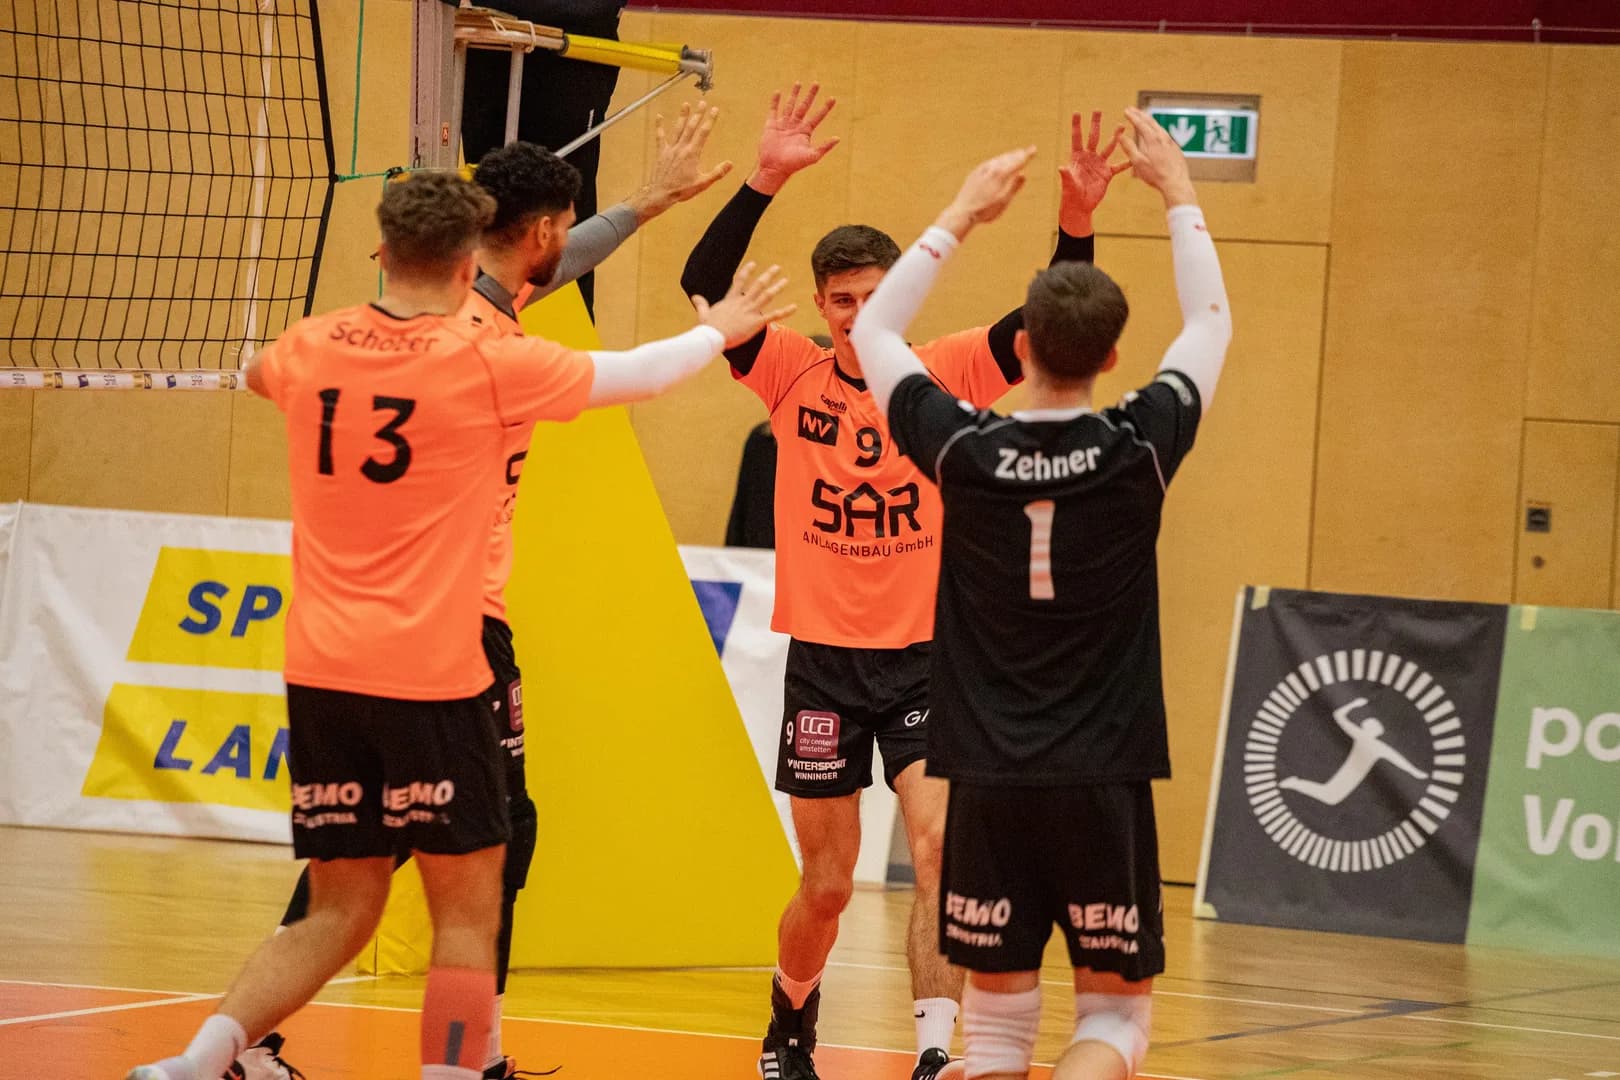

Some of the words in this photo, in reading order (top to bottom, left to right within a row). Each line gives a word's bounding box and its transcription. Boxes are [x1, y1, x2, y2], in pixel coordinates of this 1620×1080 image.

[318, 388, 416, 484] 13
[802, 411, 832, 438] NV
[855, 426, 882, 467] 9
[995, 446, 1101, 481] Zehner
[812, 478, 921, 538] SAR
[803, 531, 891, 557] ANLAGENBAU
[895, 535, 933, 554] GmbH
[1024, 500, 1055, 600] 1
[786, 721, 794, 745] 9
[811, 738, 832, 747] center
[795, 771, 838, 781] WINNINGER
